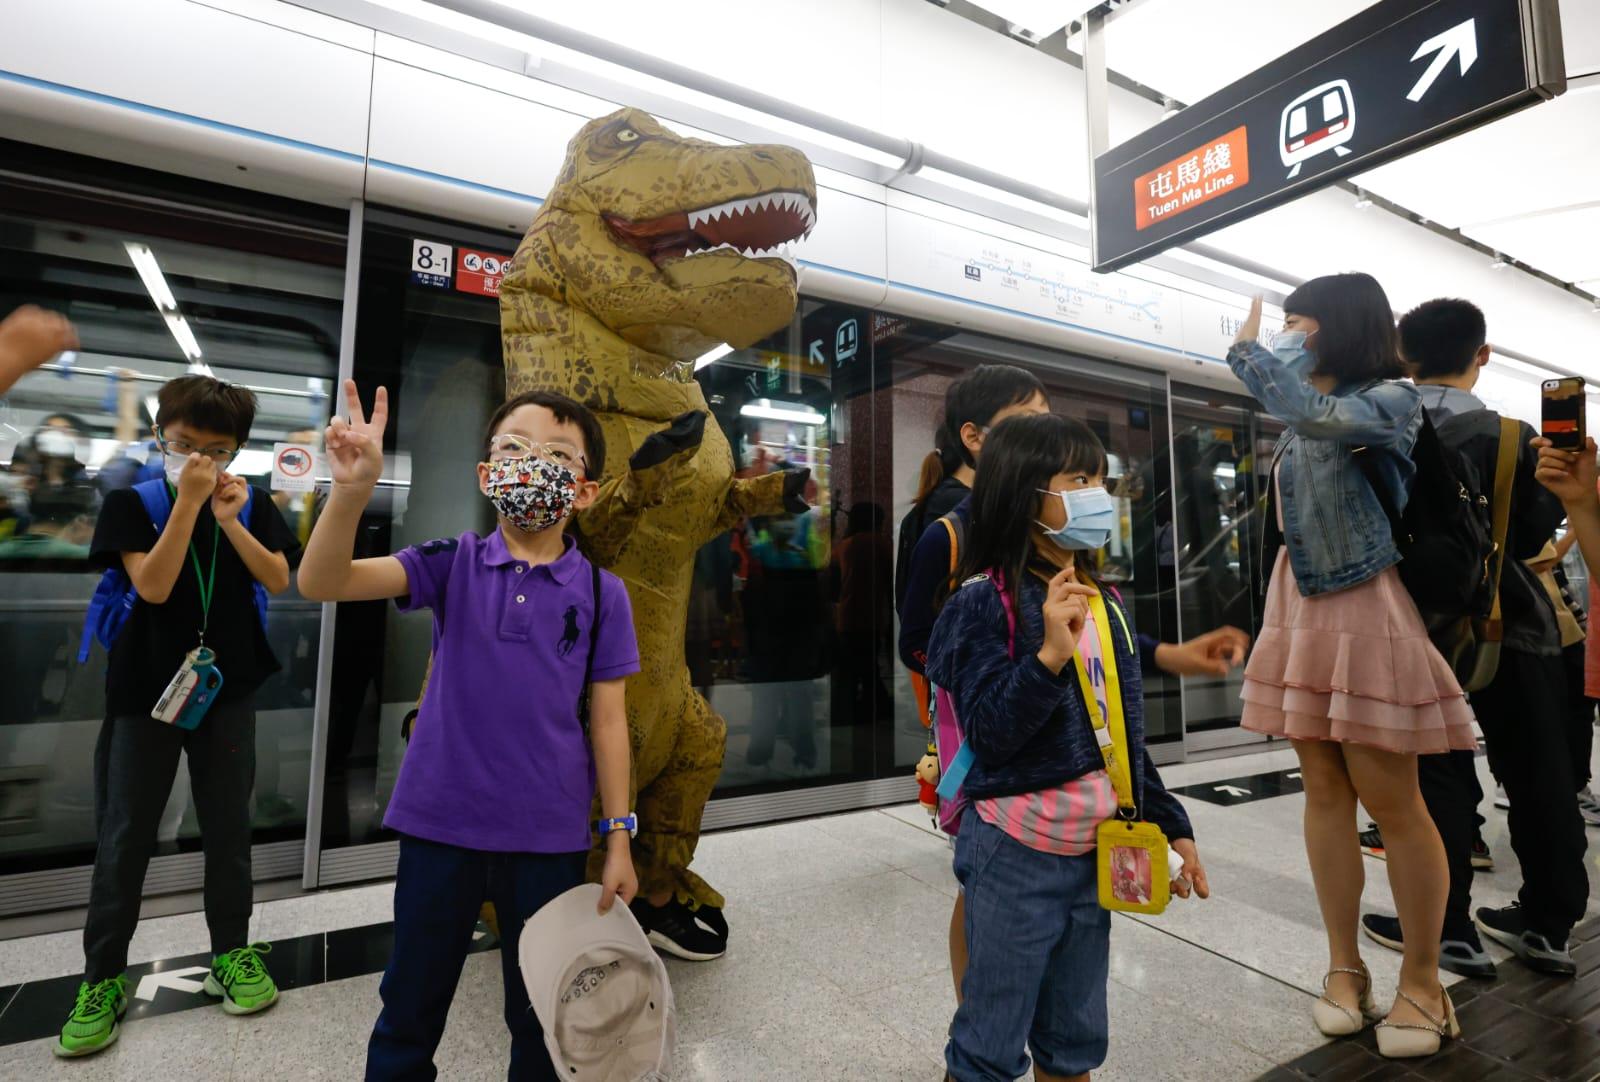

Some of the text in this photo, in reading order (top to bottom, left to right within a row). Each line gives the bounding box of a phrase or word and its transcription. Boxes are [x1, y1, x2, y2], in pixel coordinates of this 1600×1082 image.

[1148, 143, 1232, 198] 屯馬綫
[1148, 174, 1234, 219] Tuen Ma Line
[417, 245, 448, 273] 8-1
